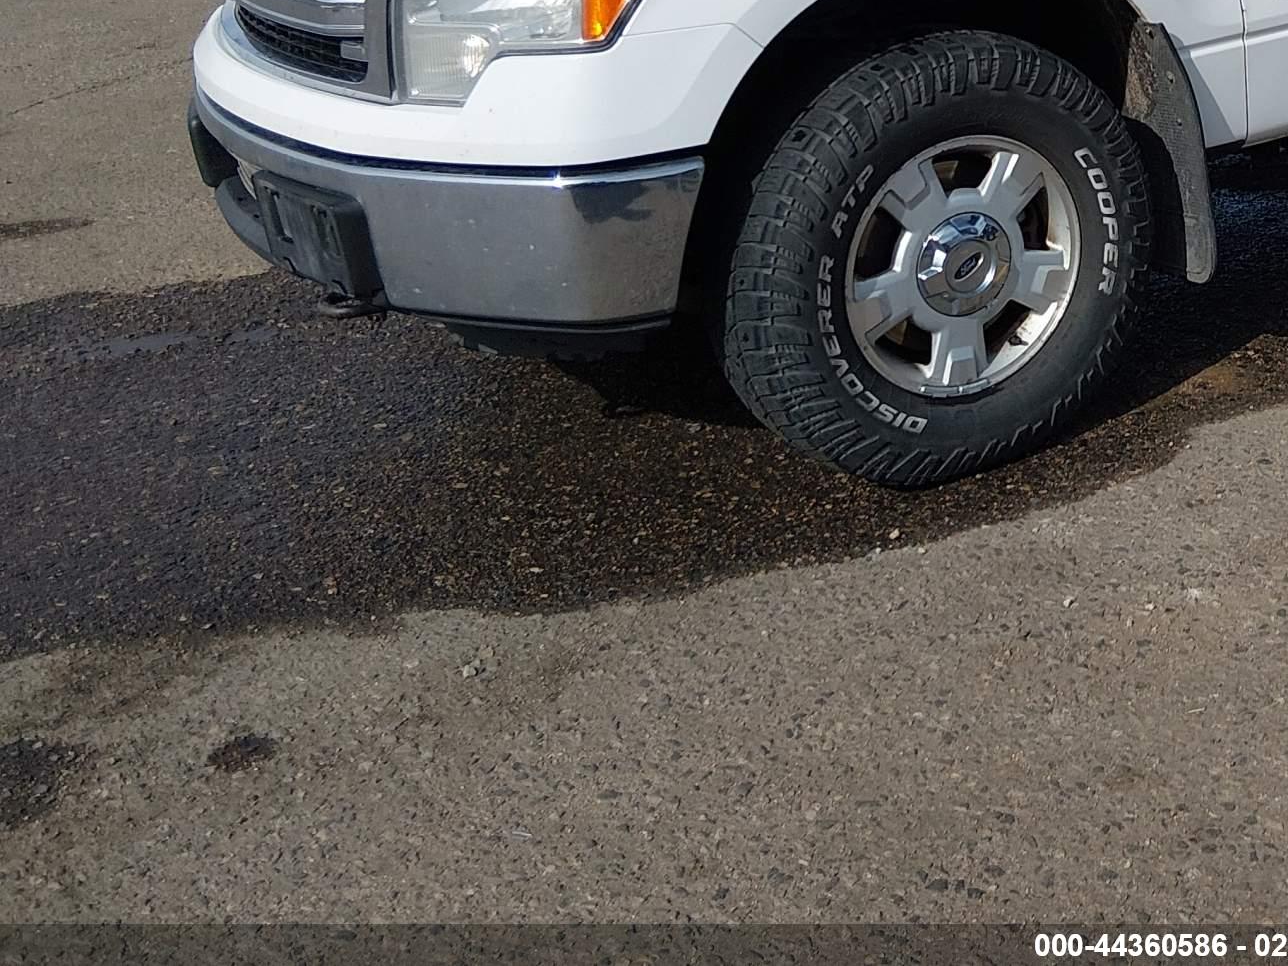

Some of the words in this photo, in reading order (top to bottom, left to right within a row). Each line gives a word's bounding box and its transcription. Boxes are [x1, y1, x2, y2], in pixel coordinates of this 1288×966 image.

[830, 164, 875, 239] ATP
[1074, 146, 1120, 296] COOPER
[816, 254, 928, 434] DISCOVERER
